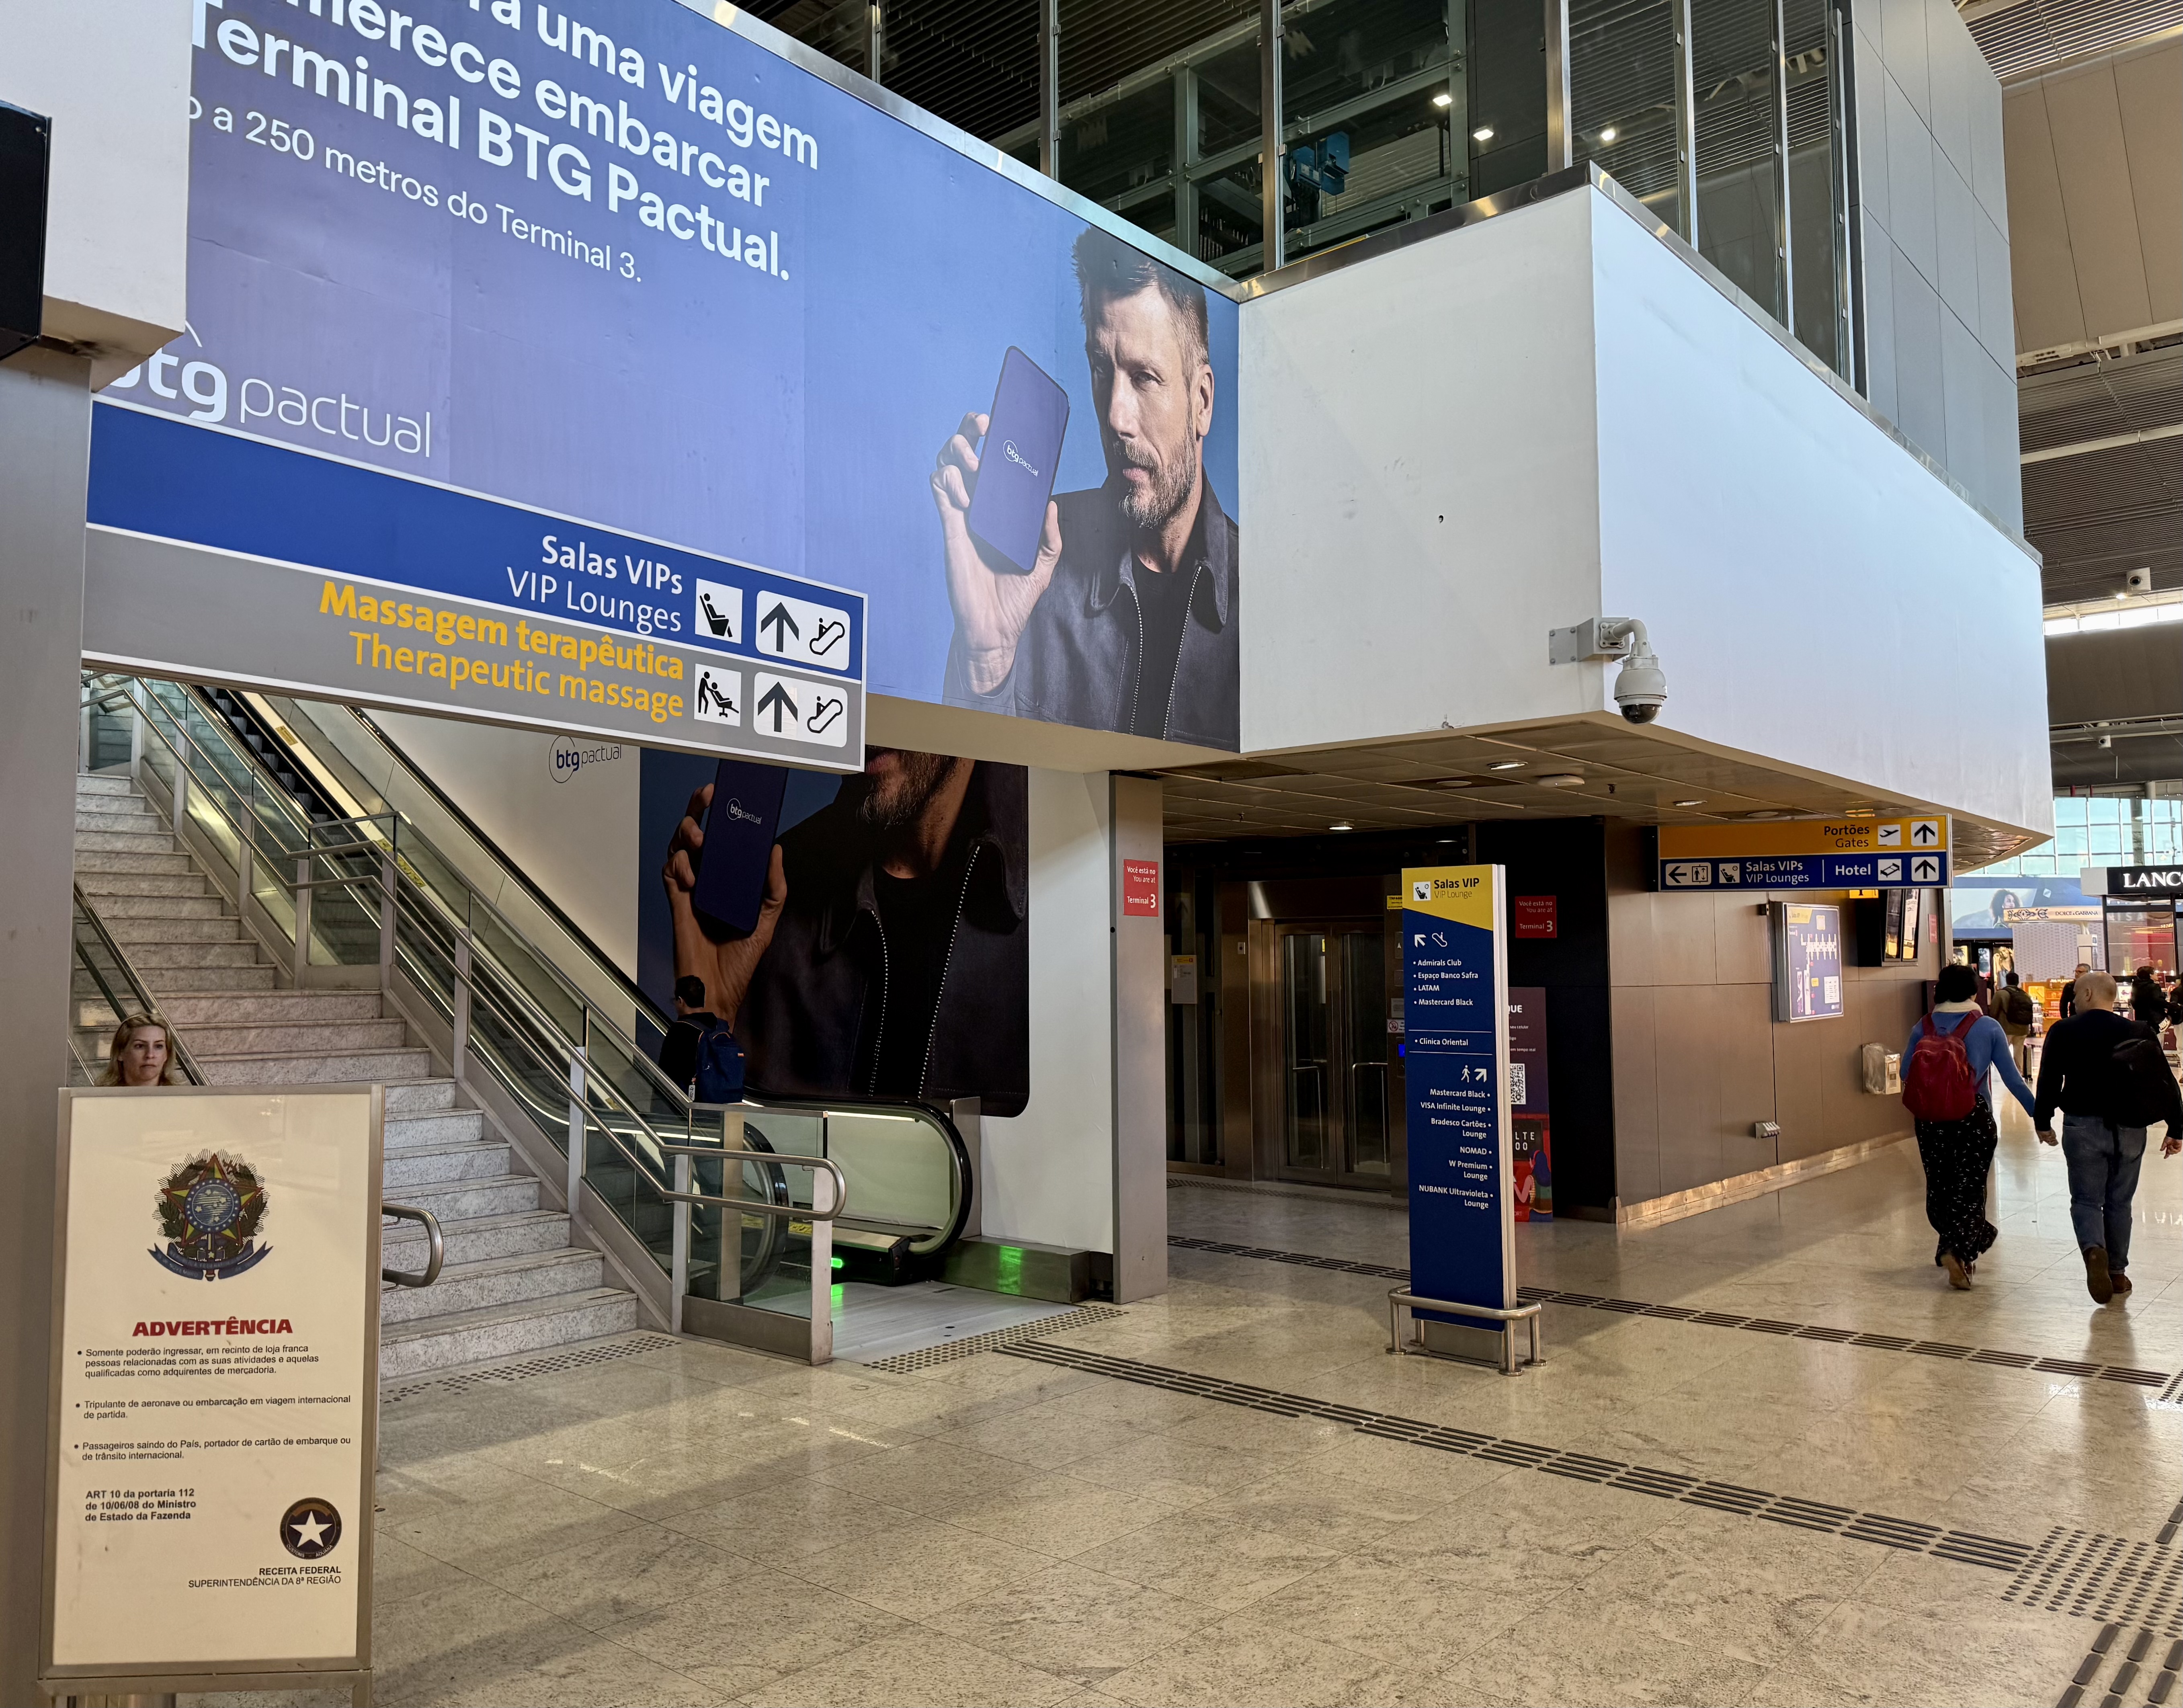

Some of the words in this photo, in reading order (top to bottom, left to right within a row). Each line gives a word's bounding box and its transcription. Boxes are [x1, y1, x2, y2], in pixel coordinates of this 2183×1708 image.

[538, 5, 644, 88] uma
[658, 63, 818, 170] viagem
[535, 79, 770, 207] embarcar
[213, 107, 233, 133] a
[246, 111, 314, 160] 250
[325, 147, 439, 207] metros
[447, 191, 488, 224] do
[496, 203, 611, 270] Terminal
[619, 251, 642, 282] 3.
[479, 108, 591, 202] BTG
[609, 162, 789, 281] Pactual.
[240, 378, 430, 457] pactual
[1007, 445, 1019, 462] btg
[1019, 458, 1038, 477] pactual
[541, 535, 618, 580] Salas
[624, 554, 683, 595] VIPs
[506, 566, 558, 603] VIP
[566, 580, 682, 634] Lounges
[318, 581, 509, 646] Massagem
[515, 620, 684, 681] terapêutica
[349, 632, 550, 697] Therapeutic
[558, 672, 684, 724] massage
[556, 749, 580, 771] btg
[582, 744, 621, 768] pactual
[730, 804, 742, 818] btg
[742, 811, 762, 824] pactual
[1824, 824, 1870, 836] Portões
[1835, 837, 1869, 848] Gates
[1746, 862, 1775, 871] Salas
[1778, 861, 1803, 871] VIPs
[1835, 863, 1871, 876] Hotel
[1434, 879, 1459, 889] Salas
[1462, 878, 1479, 887] VIP
[1746, 873, 1763, 883] VIP
[1766, 873, 1810, 885] Lounges
[2123, 871, 2183, 888] LANC
[1447, 890, 1472, 899] Lounge
[1150, 894, 1156, 908] 3
[1547, 921, 1553, 932] 3
[1418, 972, 1439, 980] Espaço
[1430, 1089, 1466, 1097] Mastercard
[1468, 1090, 1485, 1098] Black
[1437, 1103, 1460, 1111] Infinite
[1462, 1104, 1486, 1113] Lounge
[1431, 1117, 1459, 1126] Bradesco
[1463, 1130, 1486, 1139] Lounge
[1460, 1147, 1487, 1155] NOMAD
[1457, 1161, 1487, 1170] Premium
[1464, 1171, 1488, 1180] Lounge
[1419, 1185, 1447, 1194] NUBANK
[1449, 1188, 1488, 1198] Ultravioleta
[1464, 1199, 1488, 1209] Lounge
[132, 1316, 293, 1337] ADVERTÊNCIA
[126, 1348, 161, 1357] poderão
[163, 1347, 203, 1356] ingressar,
[265, 1345, 280, 1354] loja
[86, 1359, 121, 1368] pessoas
[123, 1357, 176, 1366] relacionadas
[286, 1354, 319, 1364] aquelas
[85, 1369, 135, 1378] qualificadas
[163, 1367, 211, 1376] adquirentes
[227, 1366, 276, 1374] mercadoria.
[84, 1400, 125, 1410] Tripulante
[196, 1398, 248, 1407] embarcação
[266, 1396, 295, 1405] viagem
[298, 1395, 351, 1403] internacional
[97, 1411, 127, 1420] partida.
[83, 1441, 134, 1450] Passageiros
[137, 1440, 164, 1448] saindo
[204, 1438, 239, 1448] portador
[255, 1437, 281, 1446] cartão
[296, 1437, 338, 1446] embarque
[95, 1452, 126, 1460] trânsito
[129, 1450, 184, 1459] internacional.
[86, 1490, 106, 1499] ART
[110, 1490, 121, 1499] 10
[123, 1490, 135, 1498] da
[137, 1489, 175, 1500] portaria
[178, 1489, 194, 1497] 112
[86, 1501, 97, 1510] de
[100, 1500, 139, 1510] 10/06/08
[142, 1501, 154, 1509] do
[158, 1499, 196, 1508] Ministro
[85, 1513, 97, 1521] de
[100, 1512, 133, 1521] Estado
[136, 1512, 148, 1520] da
[151, 1511, 191, 1520] Fazenda
[316, 1545, 333, 1557] ADUANA
[259, 1567, 297, 1576] RECEITA
[300, 1566, 341, 1575] FEDERAL
[189, 1577, 279, 1588] SUPERINTENDÊNCIA
[281, 1577, 293, 1585] DA
[295, 1577, 304, 1585] 8ª
[307, 1575, 341, 1585] REGIÃO
